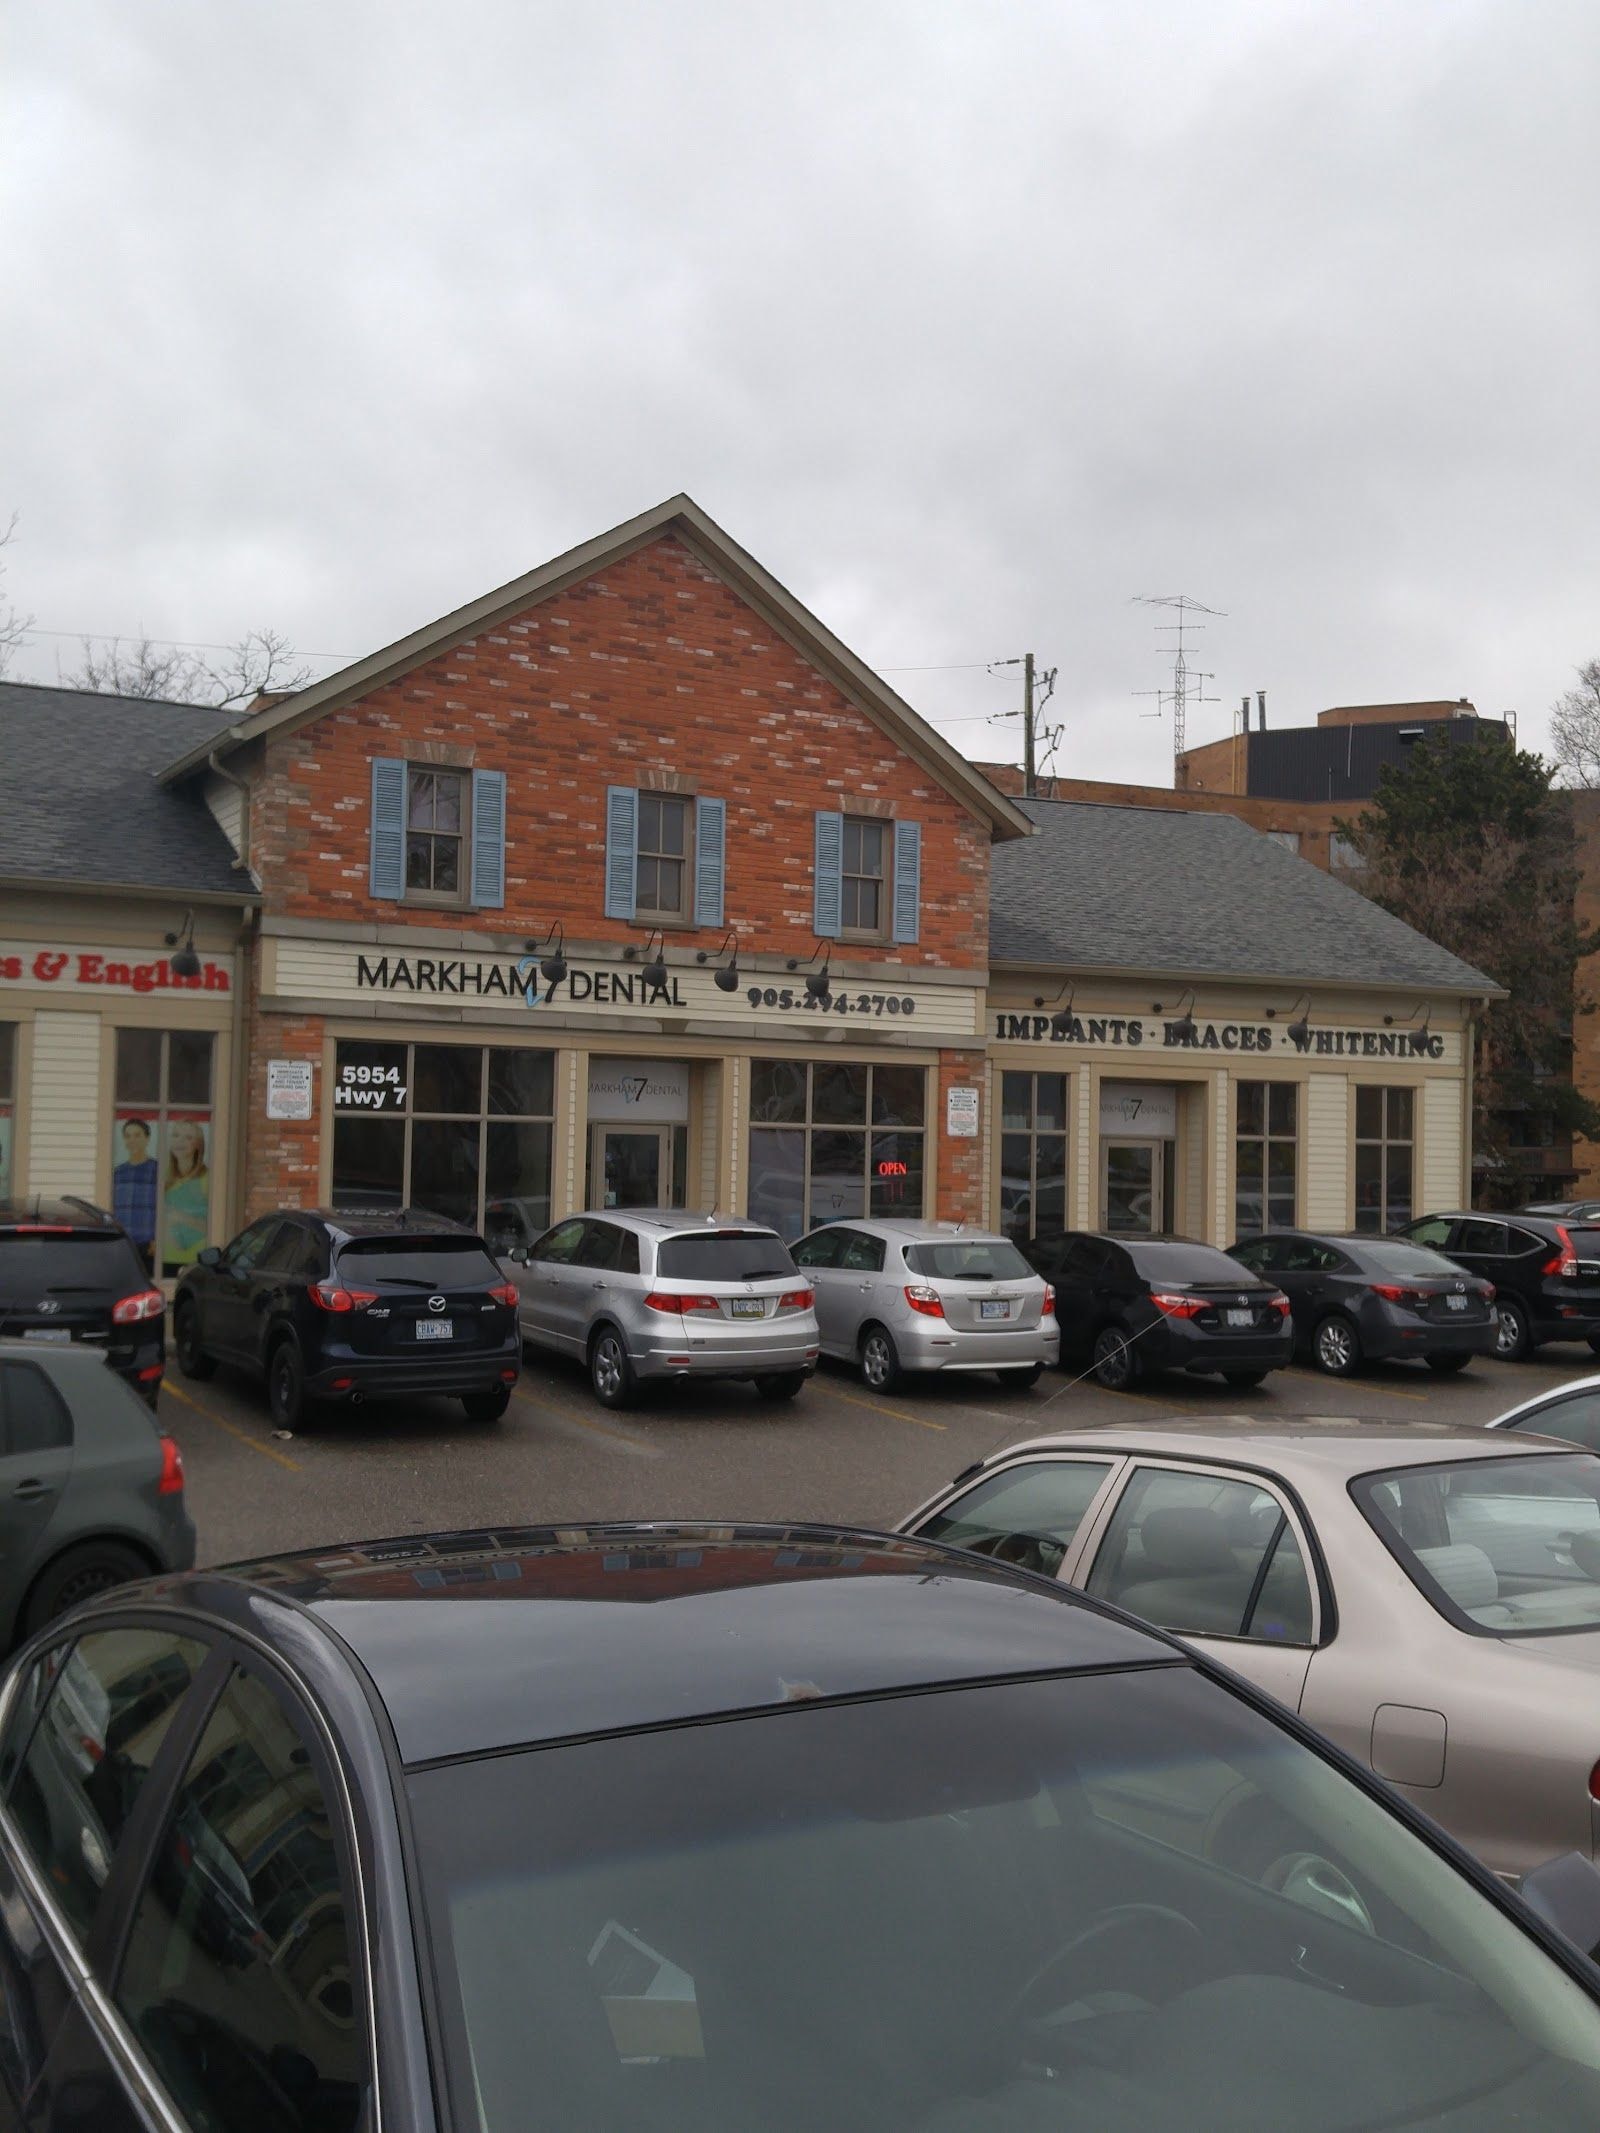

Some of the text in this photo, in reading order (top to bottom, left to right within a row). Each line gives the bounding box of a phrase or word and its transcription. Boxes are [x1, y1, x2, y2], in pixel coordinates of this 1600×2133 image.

[33, 952, 69, 981] &
[357, 955, 537, 997] MARKHAM
[569, 969, 687, 1007] DENTAL
[747, 987, 915, 1016] 905.294.2700
[996, 1014, 1445, 1059] IMPLANTS BRACES WHITENING
[342, 1065, 400, 1084] 5954
[335, 1086, 407, 1109] Hwy 7
[633, 1078, 648, 1101] 7
[646, 1085, 682, 1096] DENTAL
[1100, 1104, 1134, 1113] ARKHAM
[1130, 1099, 1143, 1119] 7
[879, 1162, 907, 1175] OPEN
